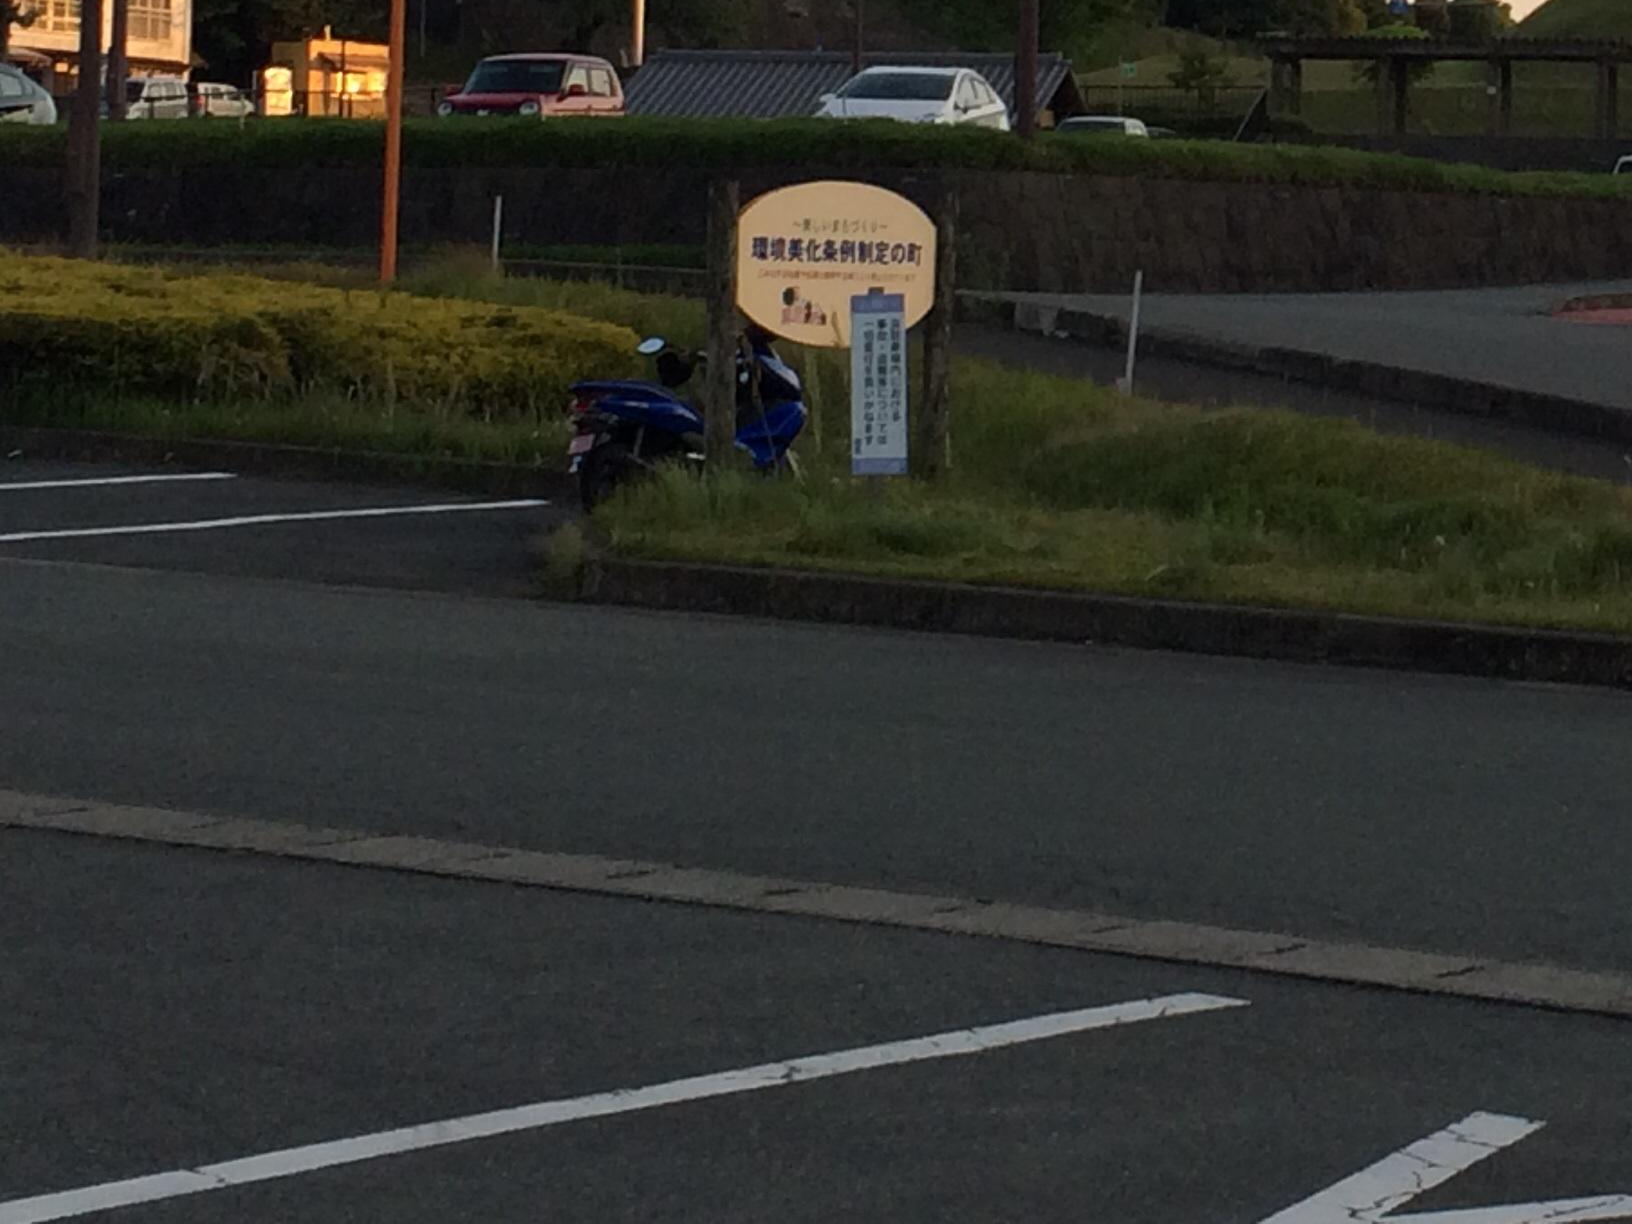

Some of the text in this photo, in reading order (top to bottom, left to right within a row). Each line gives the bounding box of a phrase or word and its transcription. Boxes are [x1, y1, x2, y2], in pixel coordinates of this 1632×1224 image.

[751, 236, 923, 267] 環境美化条例制定の町
